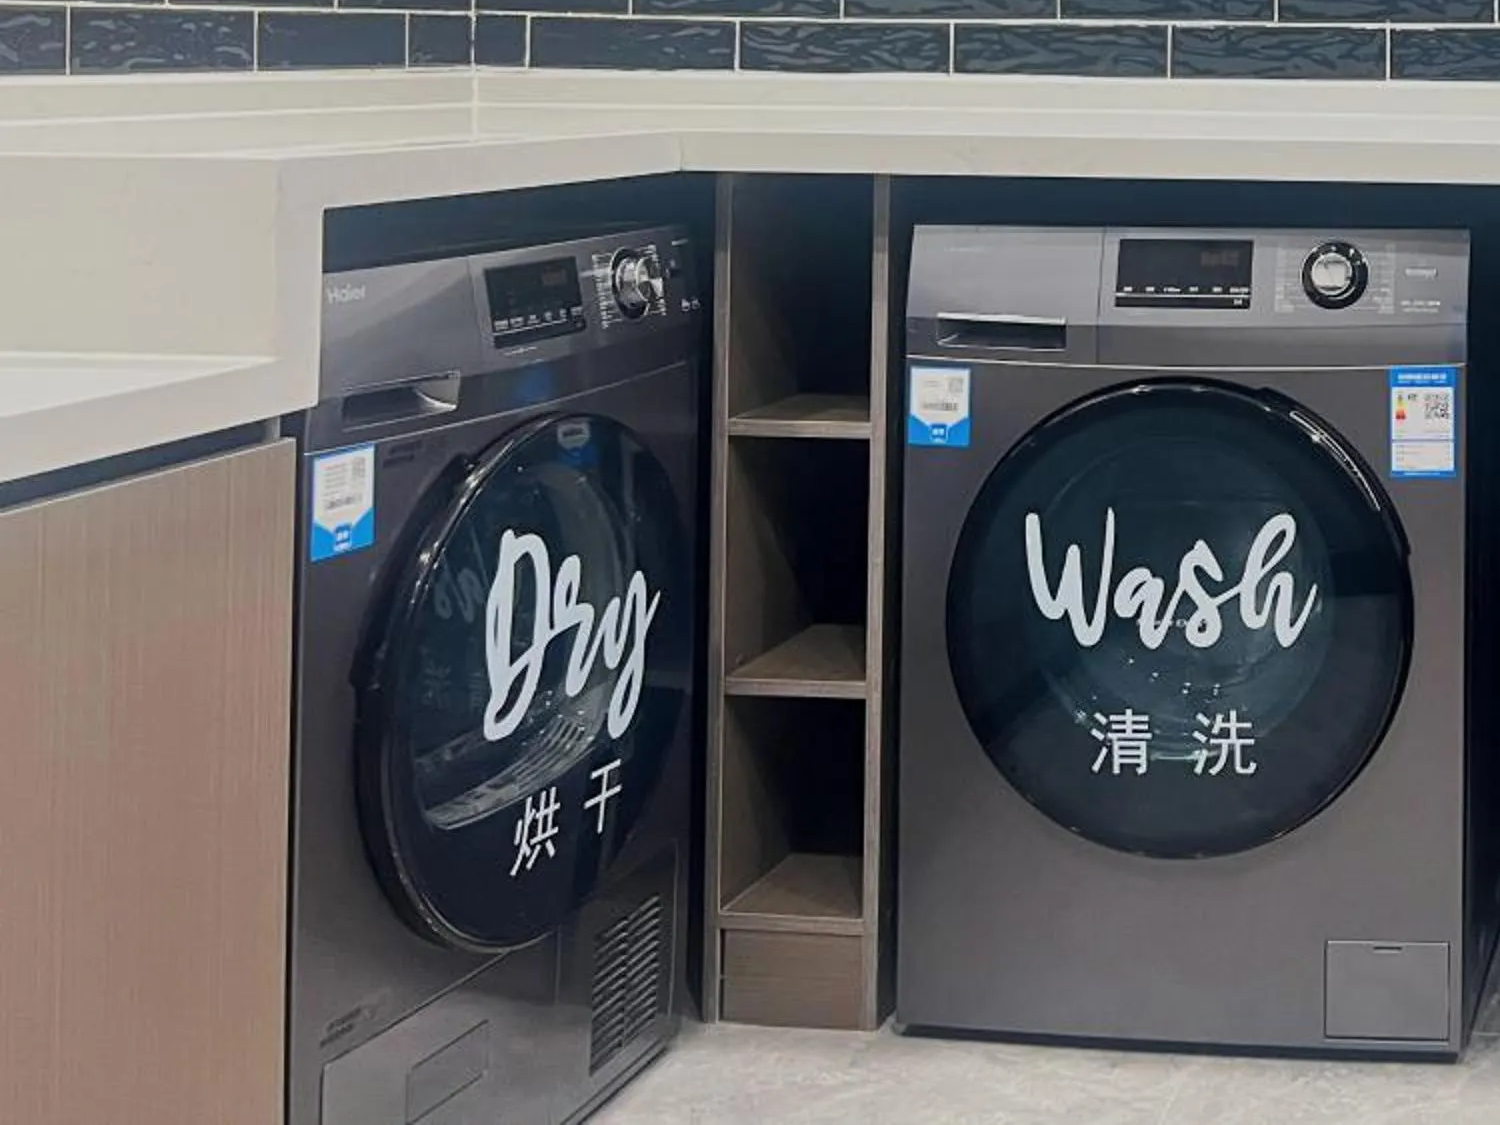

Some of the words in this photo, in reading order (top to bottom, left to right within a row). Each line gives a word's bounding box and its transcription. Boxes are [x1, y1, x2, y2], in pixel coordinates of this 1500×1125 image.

[326, 283, 366, 304] Haier
[482, 528, 661, 742] Dry
[1024, 507, 1318, 650] Wash
